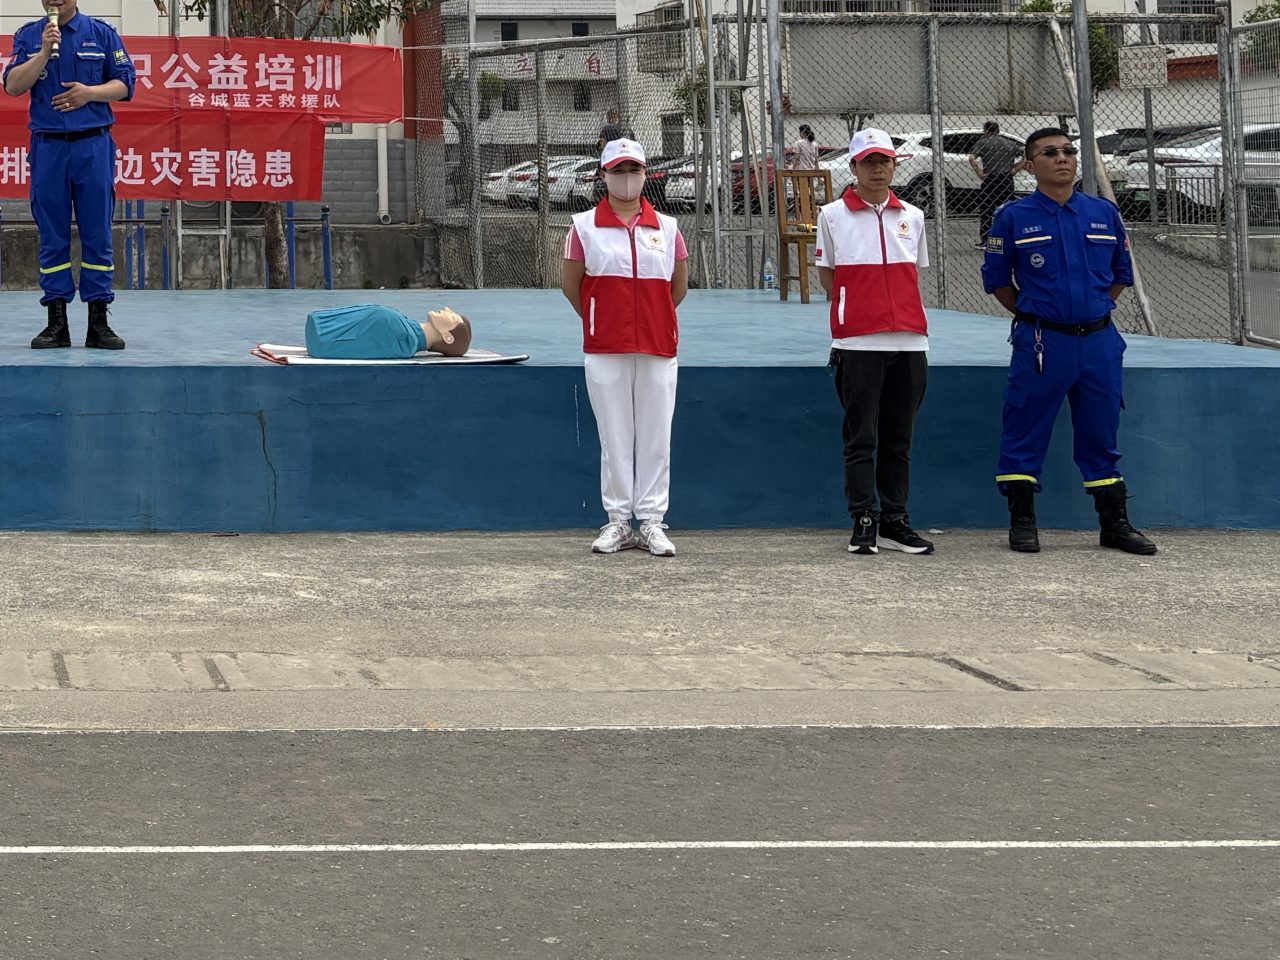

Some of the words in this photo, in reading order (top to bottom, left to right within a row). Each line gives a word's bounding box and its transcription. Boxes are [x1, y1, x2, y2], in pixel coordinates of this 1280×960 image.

[188, 91, 342, 109] 谷城蓝天救援队
